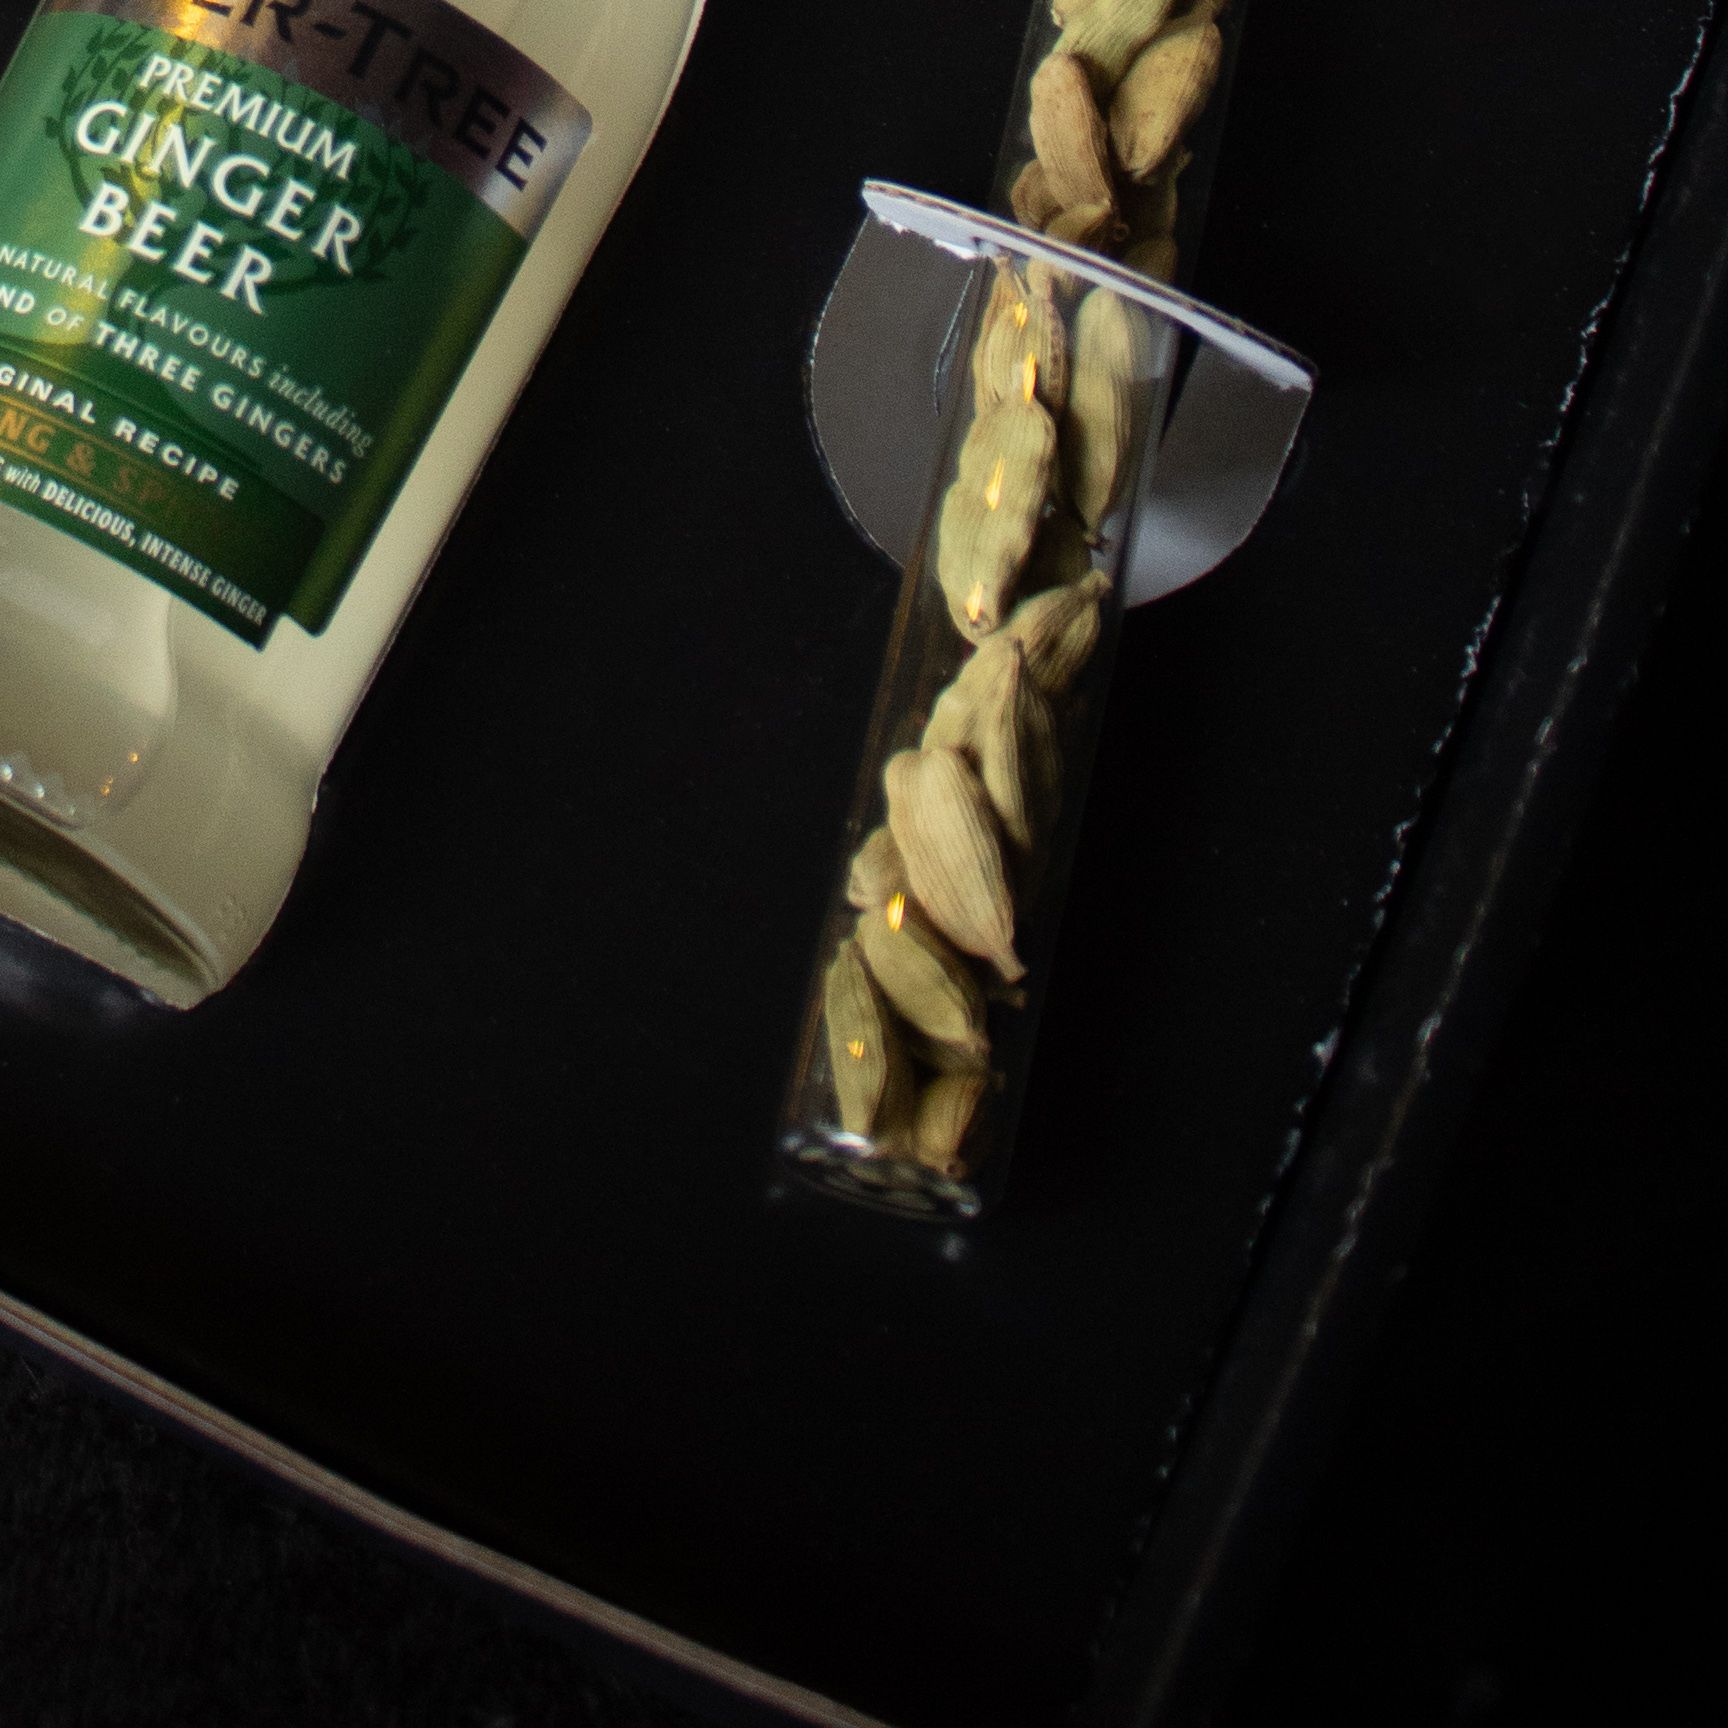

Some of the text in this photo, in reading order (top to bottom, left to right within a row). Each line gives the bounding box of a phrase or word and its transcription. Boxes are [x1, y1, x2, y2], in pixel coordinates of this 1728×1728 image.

[76, 100, 362, 275] GINGER
[139, 52, 357, 180] PREMIUM
[78, 181, 273, 315] BEER
[47, 307, 85, 331] OF
[96, 320, 202, 392] THREE
[211, 383, 347, 485] GINGERS
[120, 288, 267, 379] FLAVOURS
[268, 364, 372, 458] including
[113, 416, 240, 501] RECIPE
[4, 463, 42, 494] with
[41, 477, 137, 548] DELICIOUS,
[138, 530, 212, 588] INTENSE
[210, 575, 268, 627] GINGER
